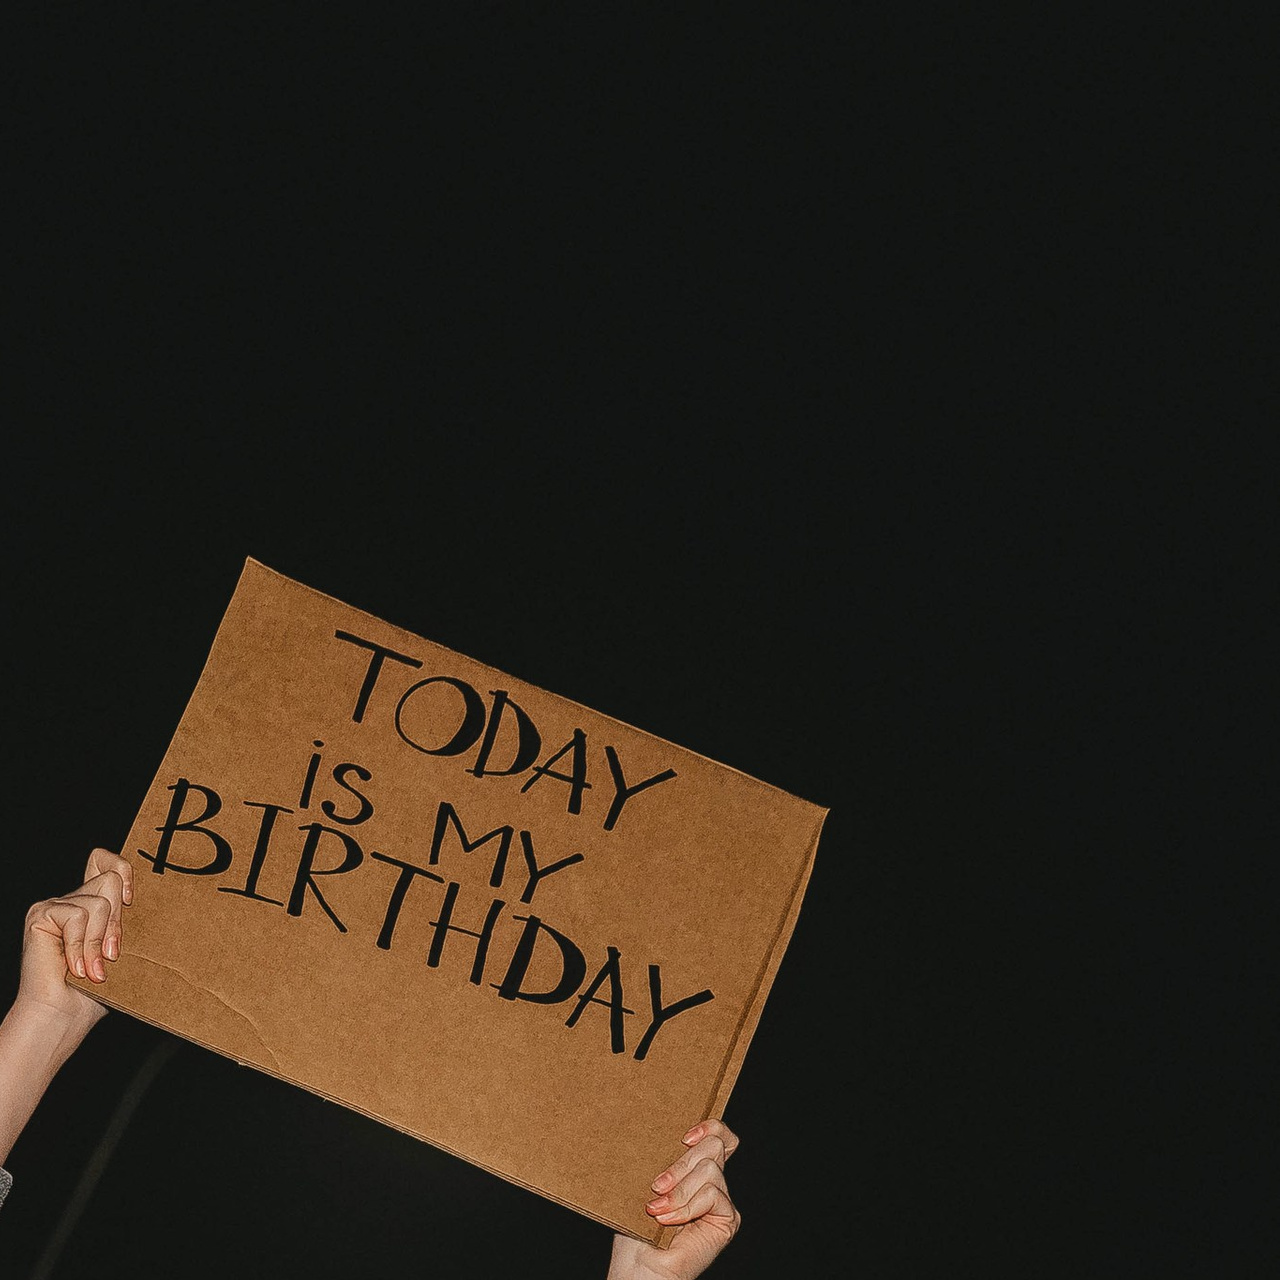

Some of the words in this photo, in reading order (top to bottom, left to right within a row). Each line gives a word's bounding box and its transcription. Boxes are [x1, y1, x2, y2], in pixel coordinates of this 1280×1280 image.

[335, 630, 677, 831] TODAY
[138, 778, 714, 1060] BIRTHDAY
[429, 802, 583, 904] MY
